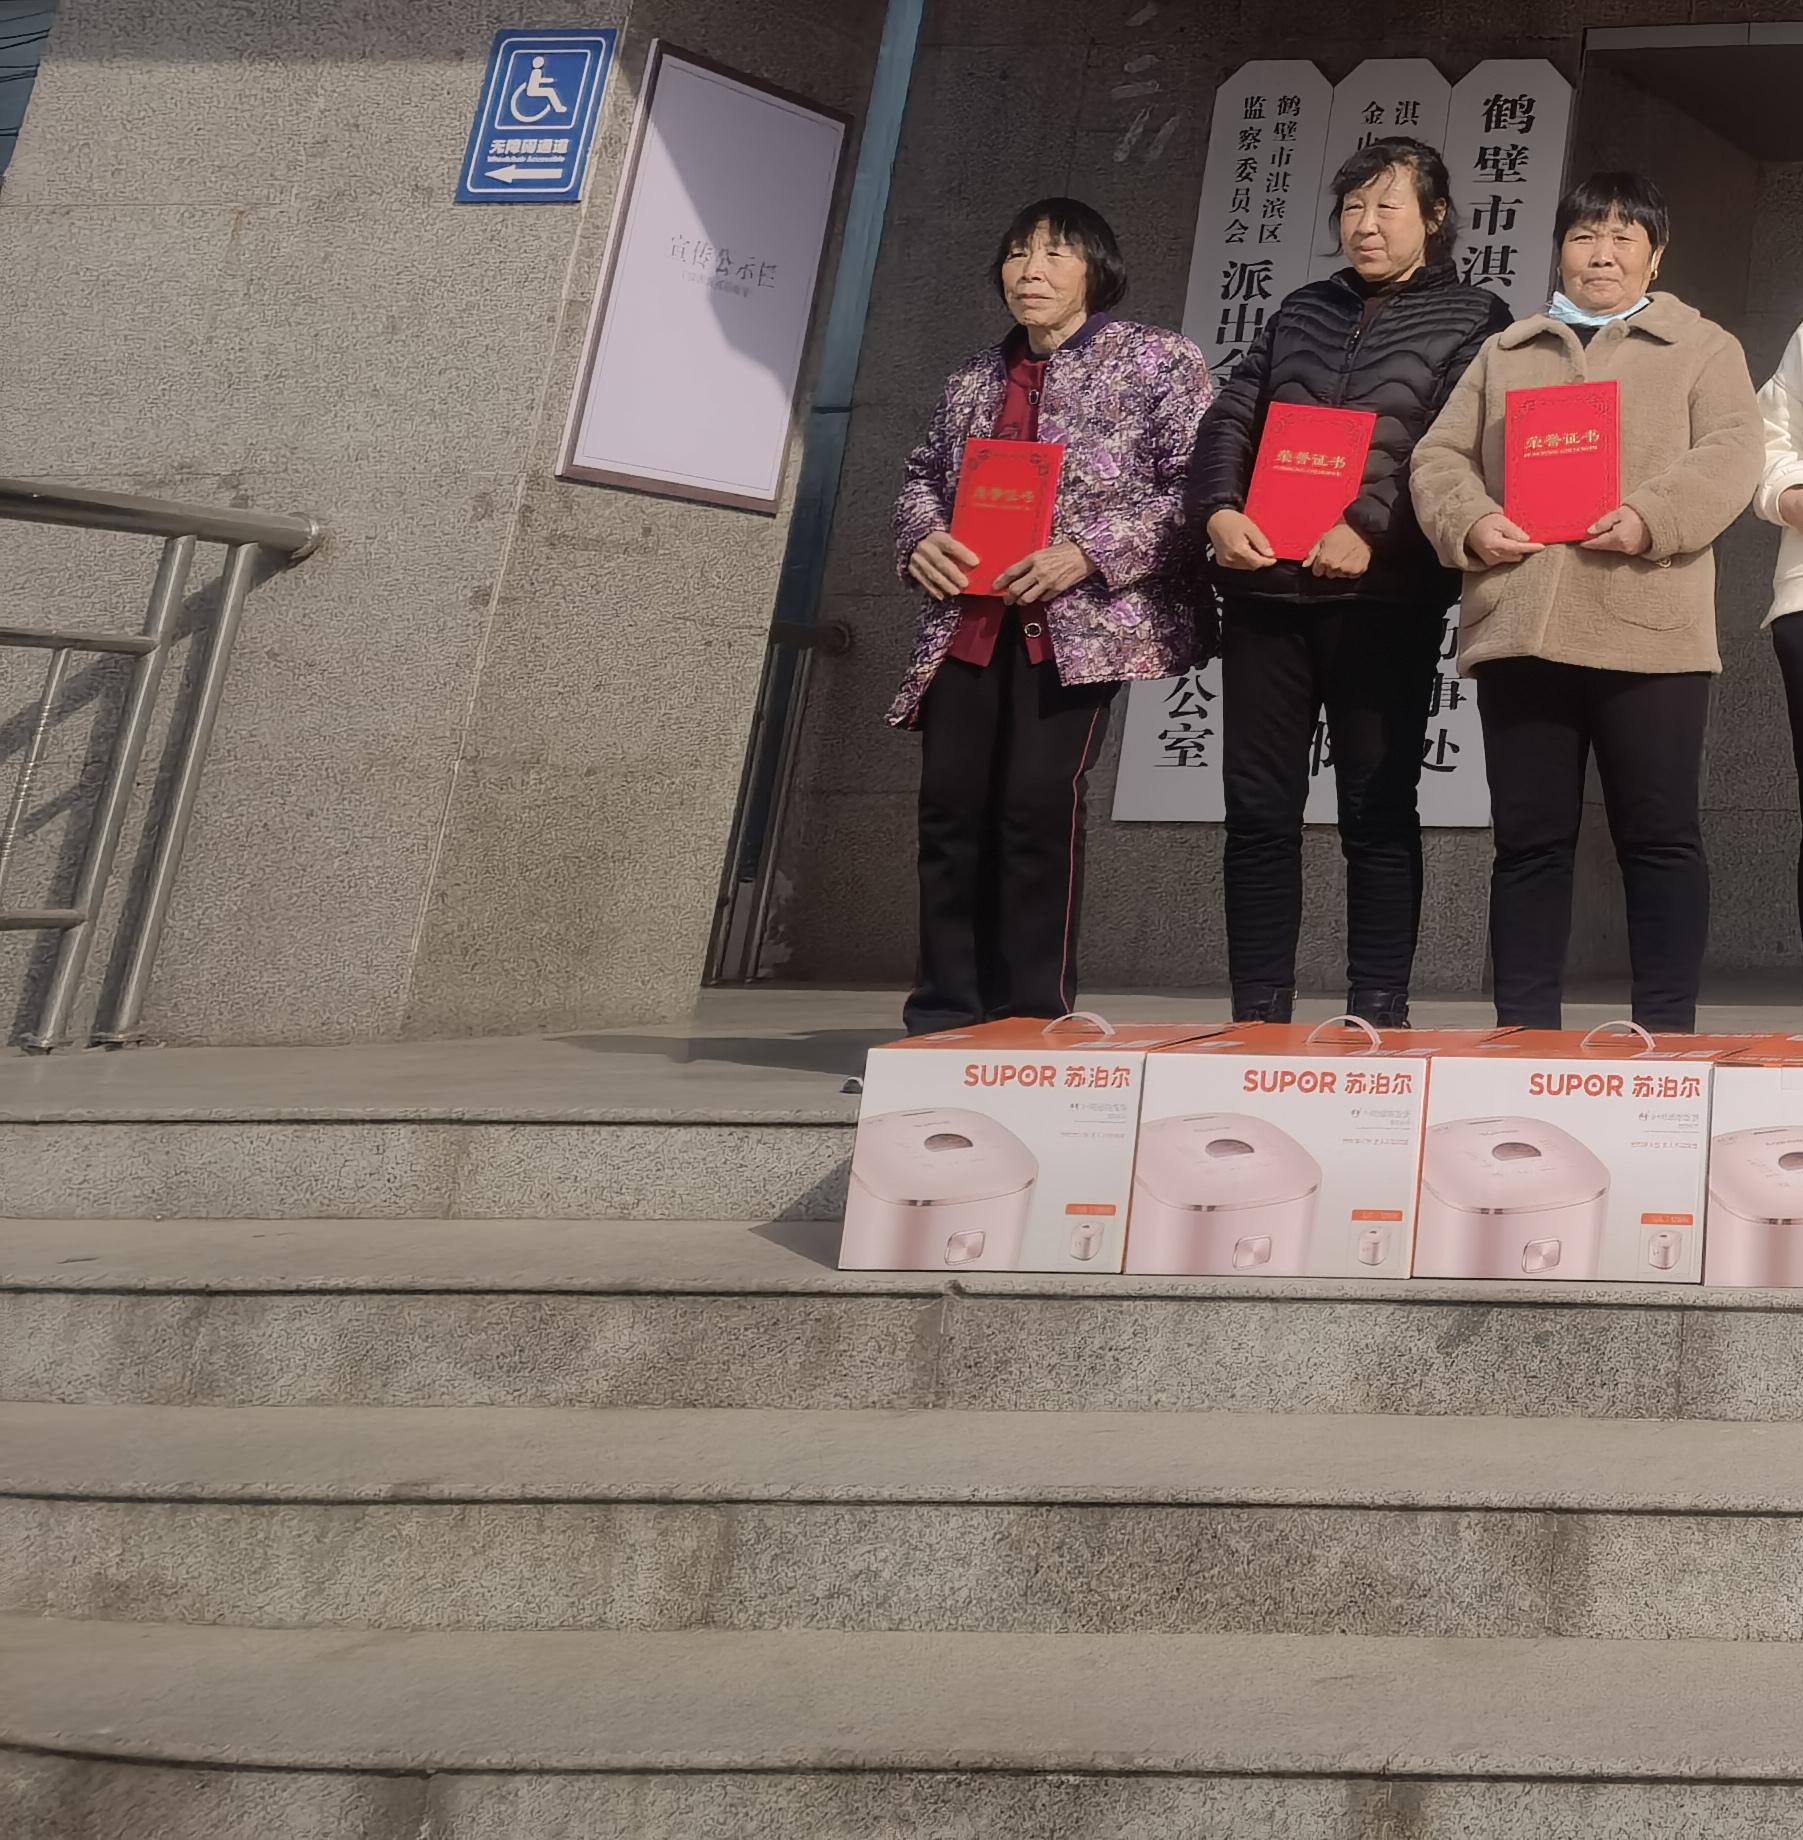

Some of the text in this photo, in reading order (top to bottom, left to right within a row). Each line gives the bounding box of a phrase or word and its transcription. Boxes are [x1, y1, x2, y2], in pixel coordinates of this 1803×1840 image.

[1223, 95, 1268, 245] 监察委员会
[1258, 95, 1301, 244] 鹤壁市淇滨区
[1460, 93, 1536, 287] 鹤壁市淇
[967, 1065, 1130, 1089] SUPOR 苏泊尔
[1244, 1070, 1412, 1095] SUPOR 苏泊尔
[1530, 1073, 1701, 1098] SUPOR 苏泊尔
